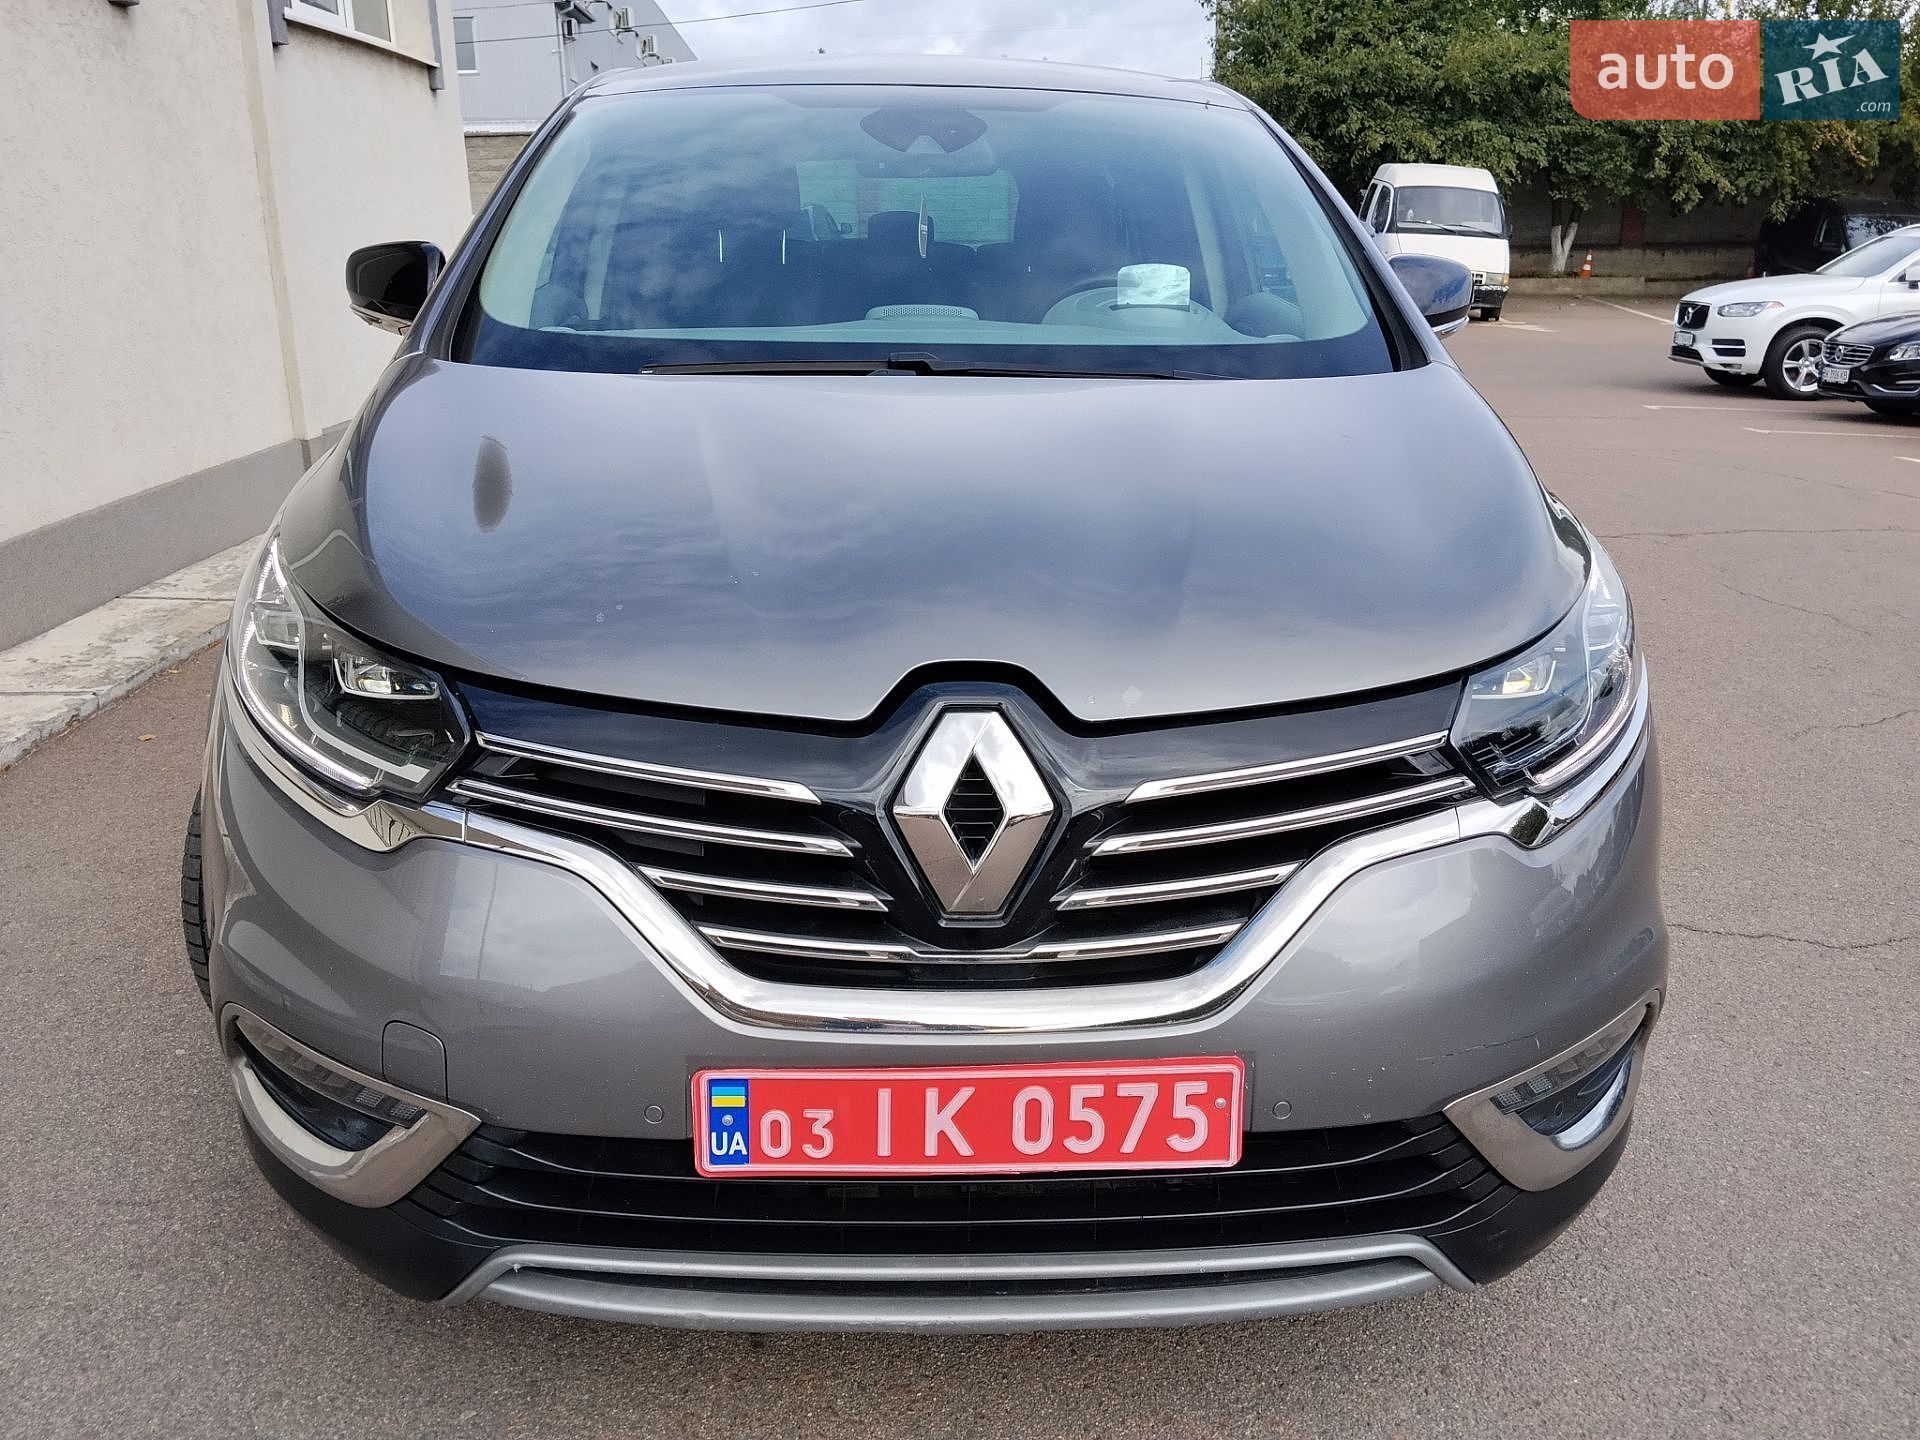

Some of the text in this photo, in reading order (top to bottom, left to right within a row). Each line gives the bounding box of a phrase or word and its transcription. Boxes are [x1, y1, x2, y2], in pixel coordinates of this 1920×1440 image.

[711, 1130, 748, 1156] UA
[759, 1109, 834, 1159] 03
[1011, 1080, 1210, 1156] 0575
